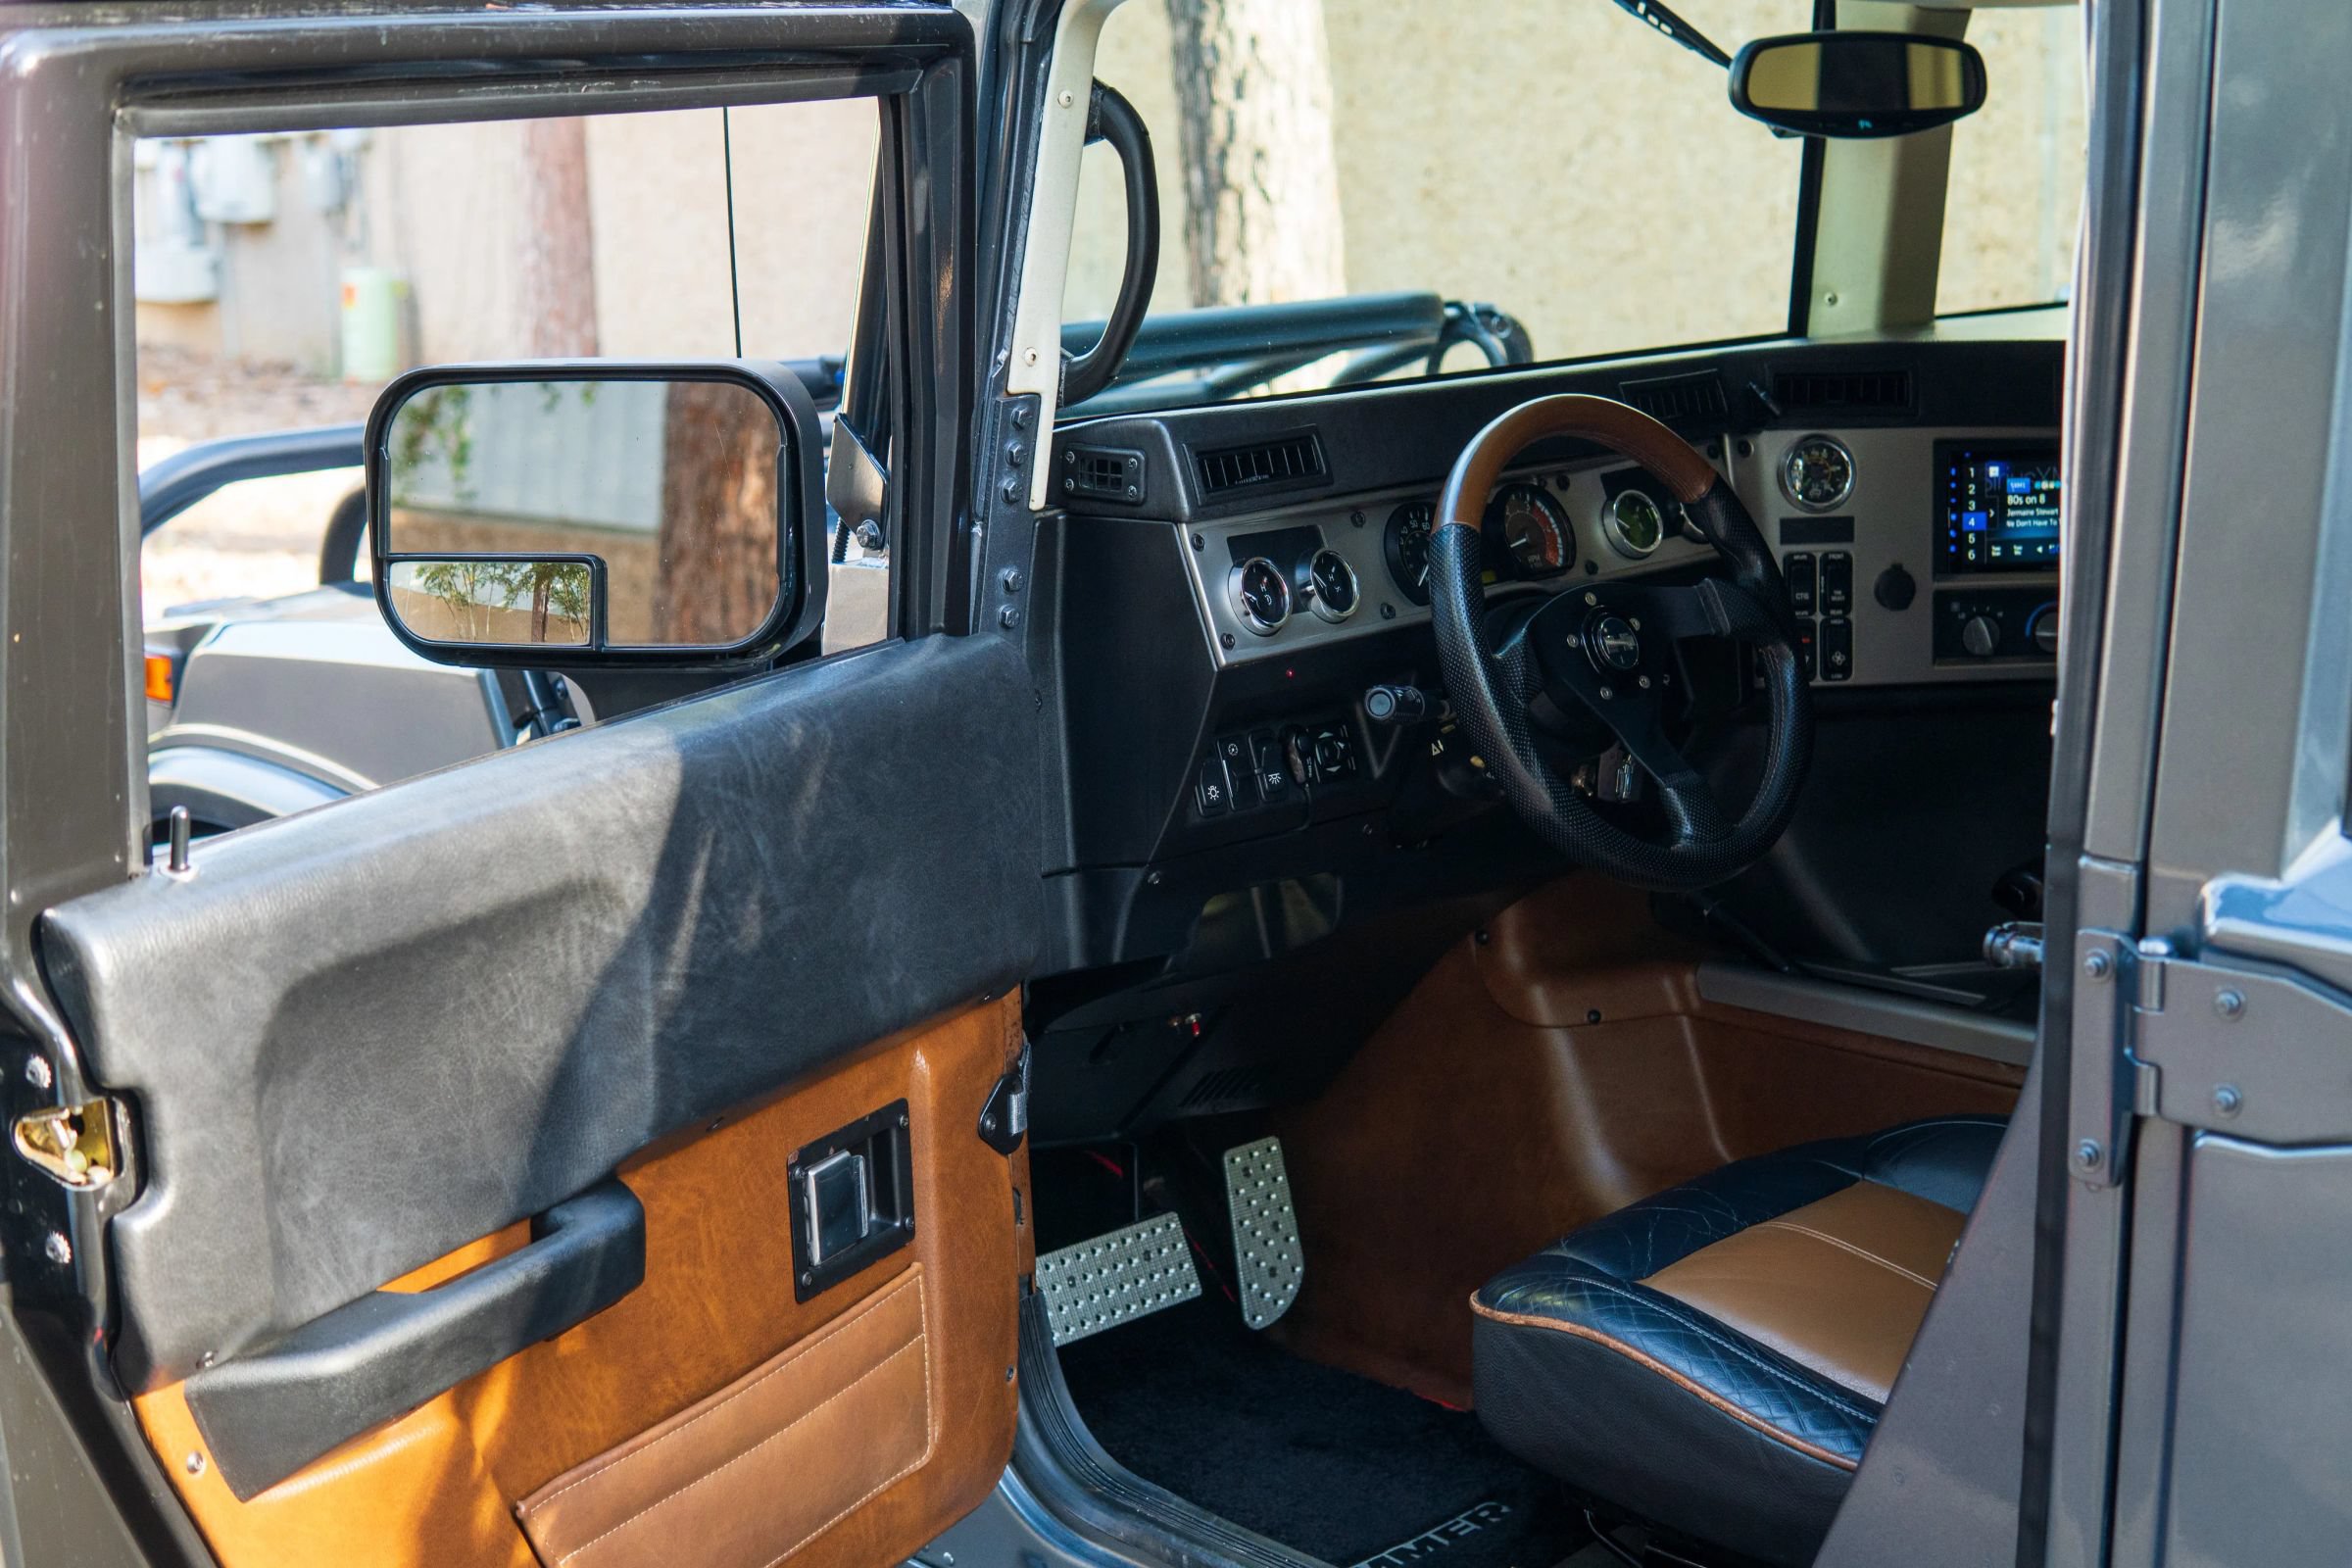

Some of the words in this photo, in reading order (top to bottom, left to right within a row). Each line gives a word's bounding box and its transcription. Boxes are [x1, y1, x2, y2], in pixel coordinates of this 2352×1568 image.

[1968, 466, 1975, 478] 1
[1968, 483, 1976, 495] 2
[1968, 500, 1976, 512] 3
[2007, 494, 2024, 506] 80s
[2025, 495, 2037, 505] on
[1968, 516, 1976, 527] 4
[1968, 533, 1976, 545] 5
[1968, 549, 1976, 562] 6
